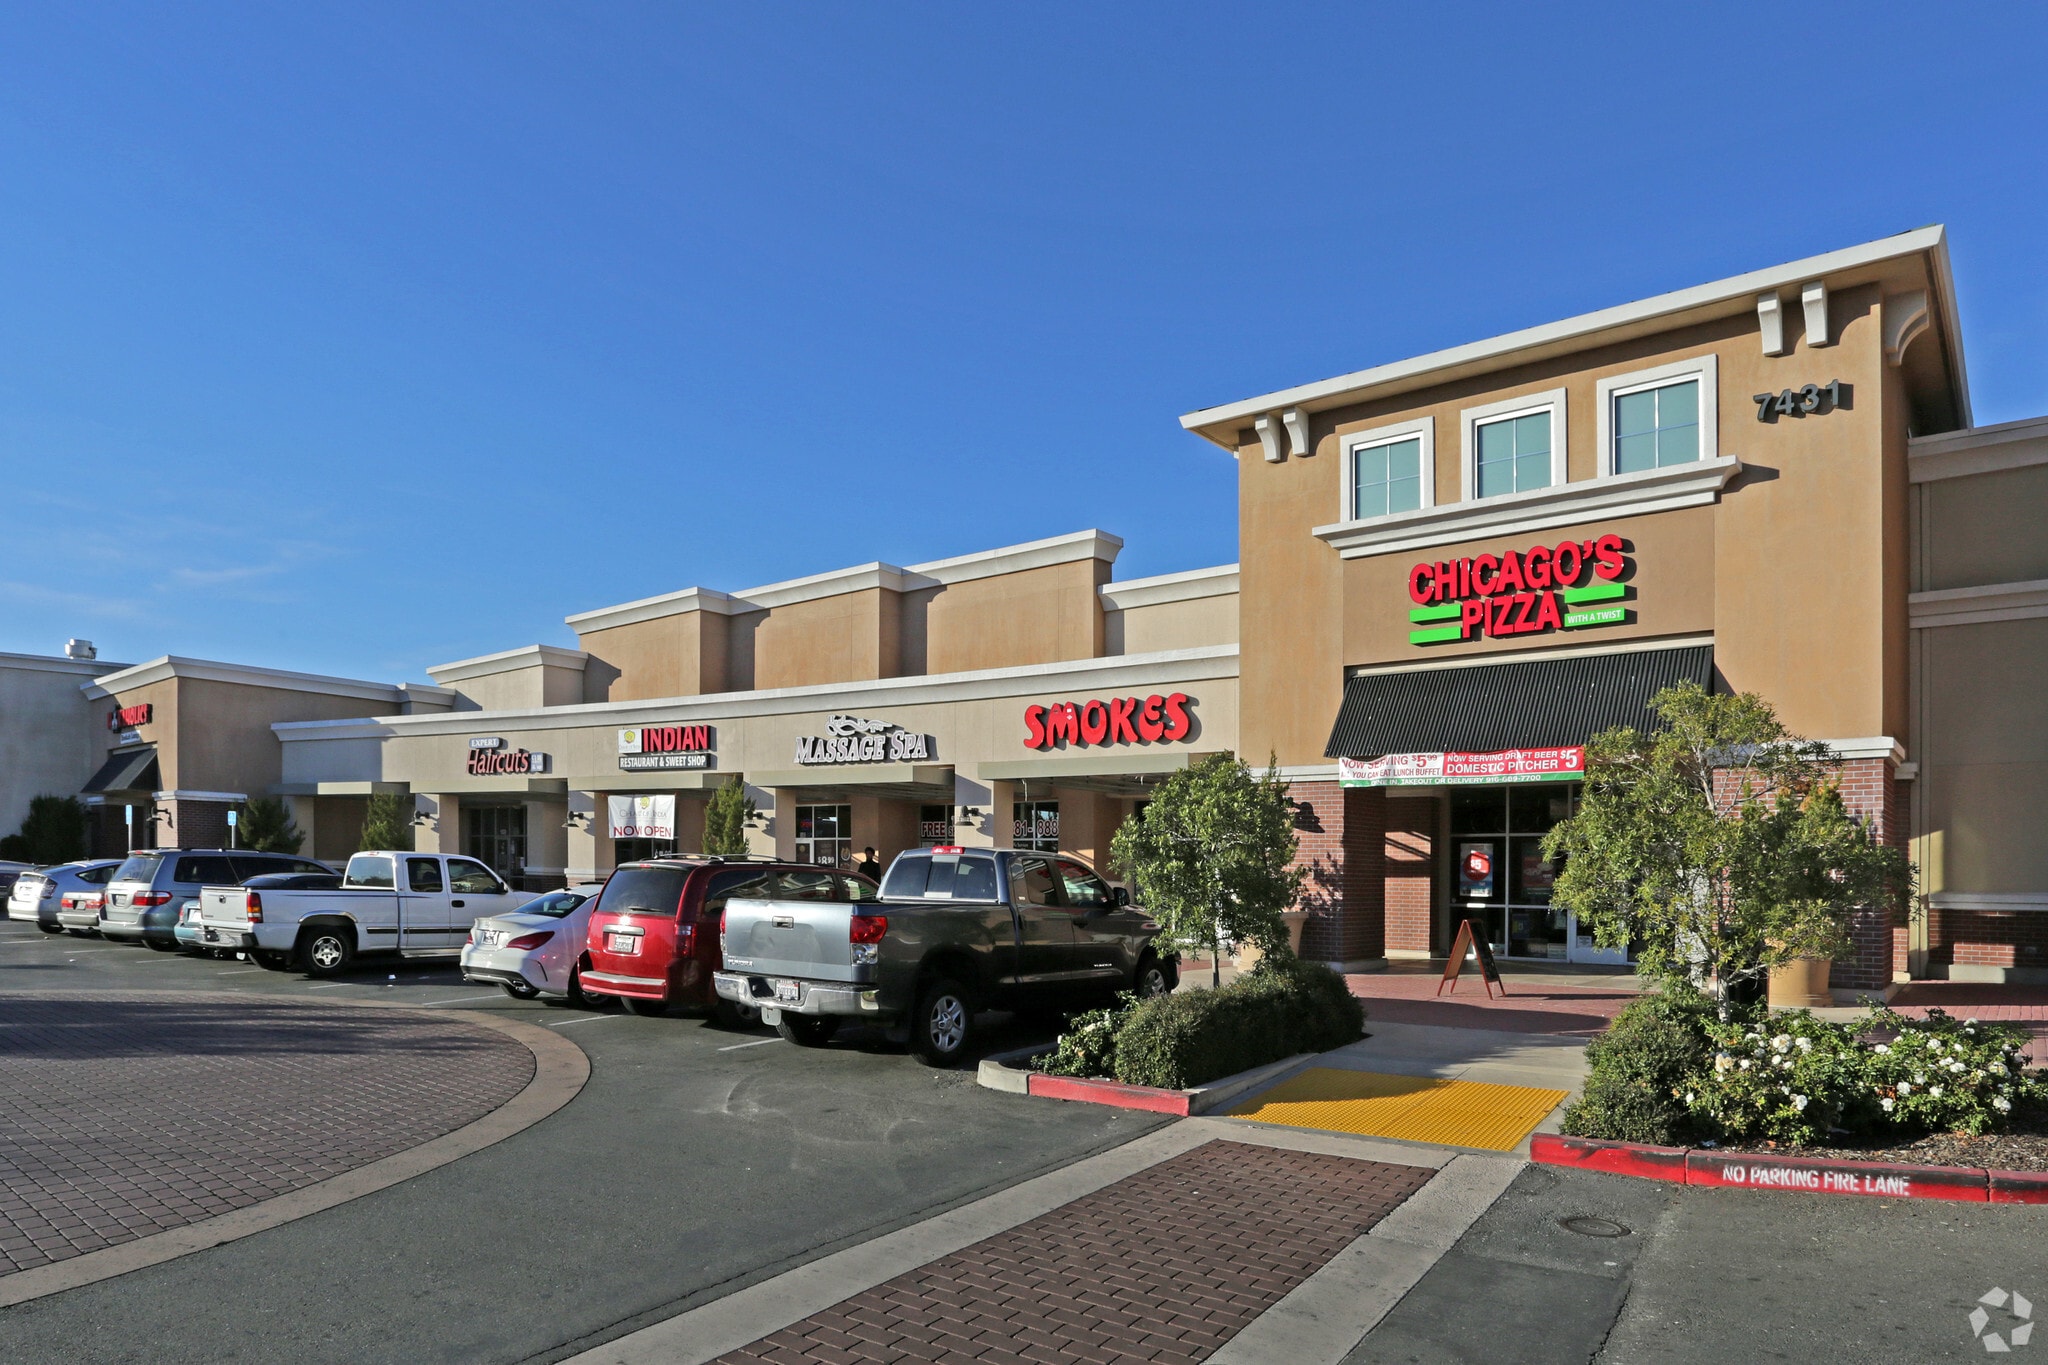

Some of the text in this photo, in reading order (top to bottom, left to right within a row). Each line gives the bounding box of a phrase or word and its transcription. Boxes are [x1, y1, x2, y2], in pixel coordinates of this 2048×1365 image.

[1752, 378, 1839, 423] 7431
[1408, 533, 1625, 605] CHICAGO'S
[1461, 590, 1562, 639] PIZZA
[1567, 609, 1622, 624] WITH A TWIST
[1023, 692, 1190, 749] SMOKES
[471, 738, 498, 748] EXPERT
[643, 724, 708, 753] INDIAN
[793, 729, 928, 764] MASSAGE SPA
[466, 748, 529, 774] Haircuts
[619, 754, 706, 768] RESTAURANT & SWEET SHOP
[1341, 759, 1365, 769] NOW
[1367, 755, 1409, 769] SERVING
[1447, 750, 1558, 763] NOW SERVING DRAFT BEER
[1560, 749, 1578, 769] $5
[1352, 771, 1366, 779] YOU
[1367, 770, 1379, 779] CAN
[1379, 769, 1392, 777] EAT
[1393, 768, 1414, 777] LUNCH
[1415, 767, 1441, 776] BUFFET
[1446, 759, 1559, 774] DOMESTIC PITCHER
[1434, 777, 1446, 785] OR
[1447, 776, 1484, 784] DELIVERY
[613, 825, 672, 838] NOW OPEN
[921, 821, 946, 837] FREE
[1722, 1164, 1911, 1197] NO PARKING FIRE LANE
